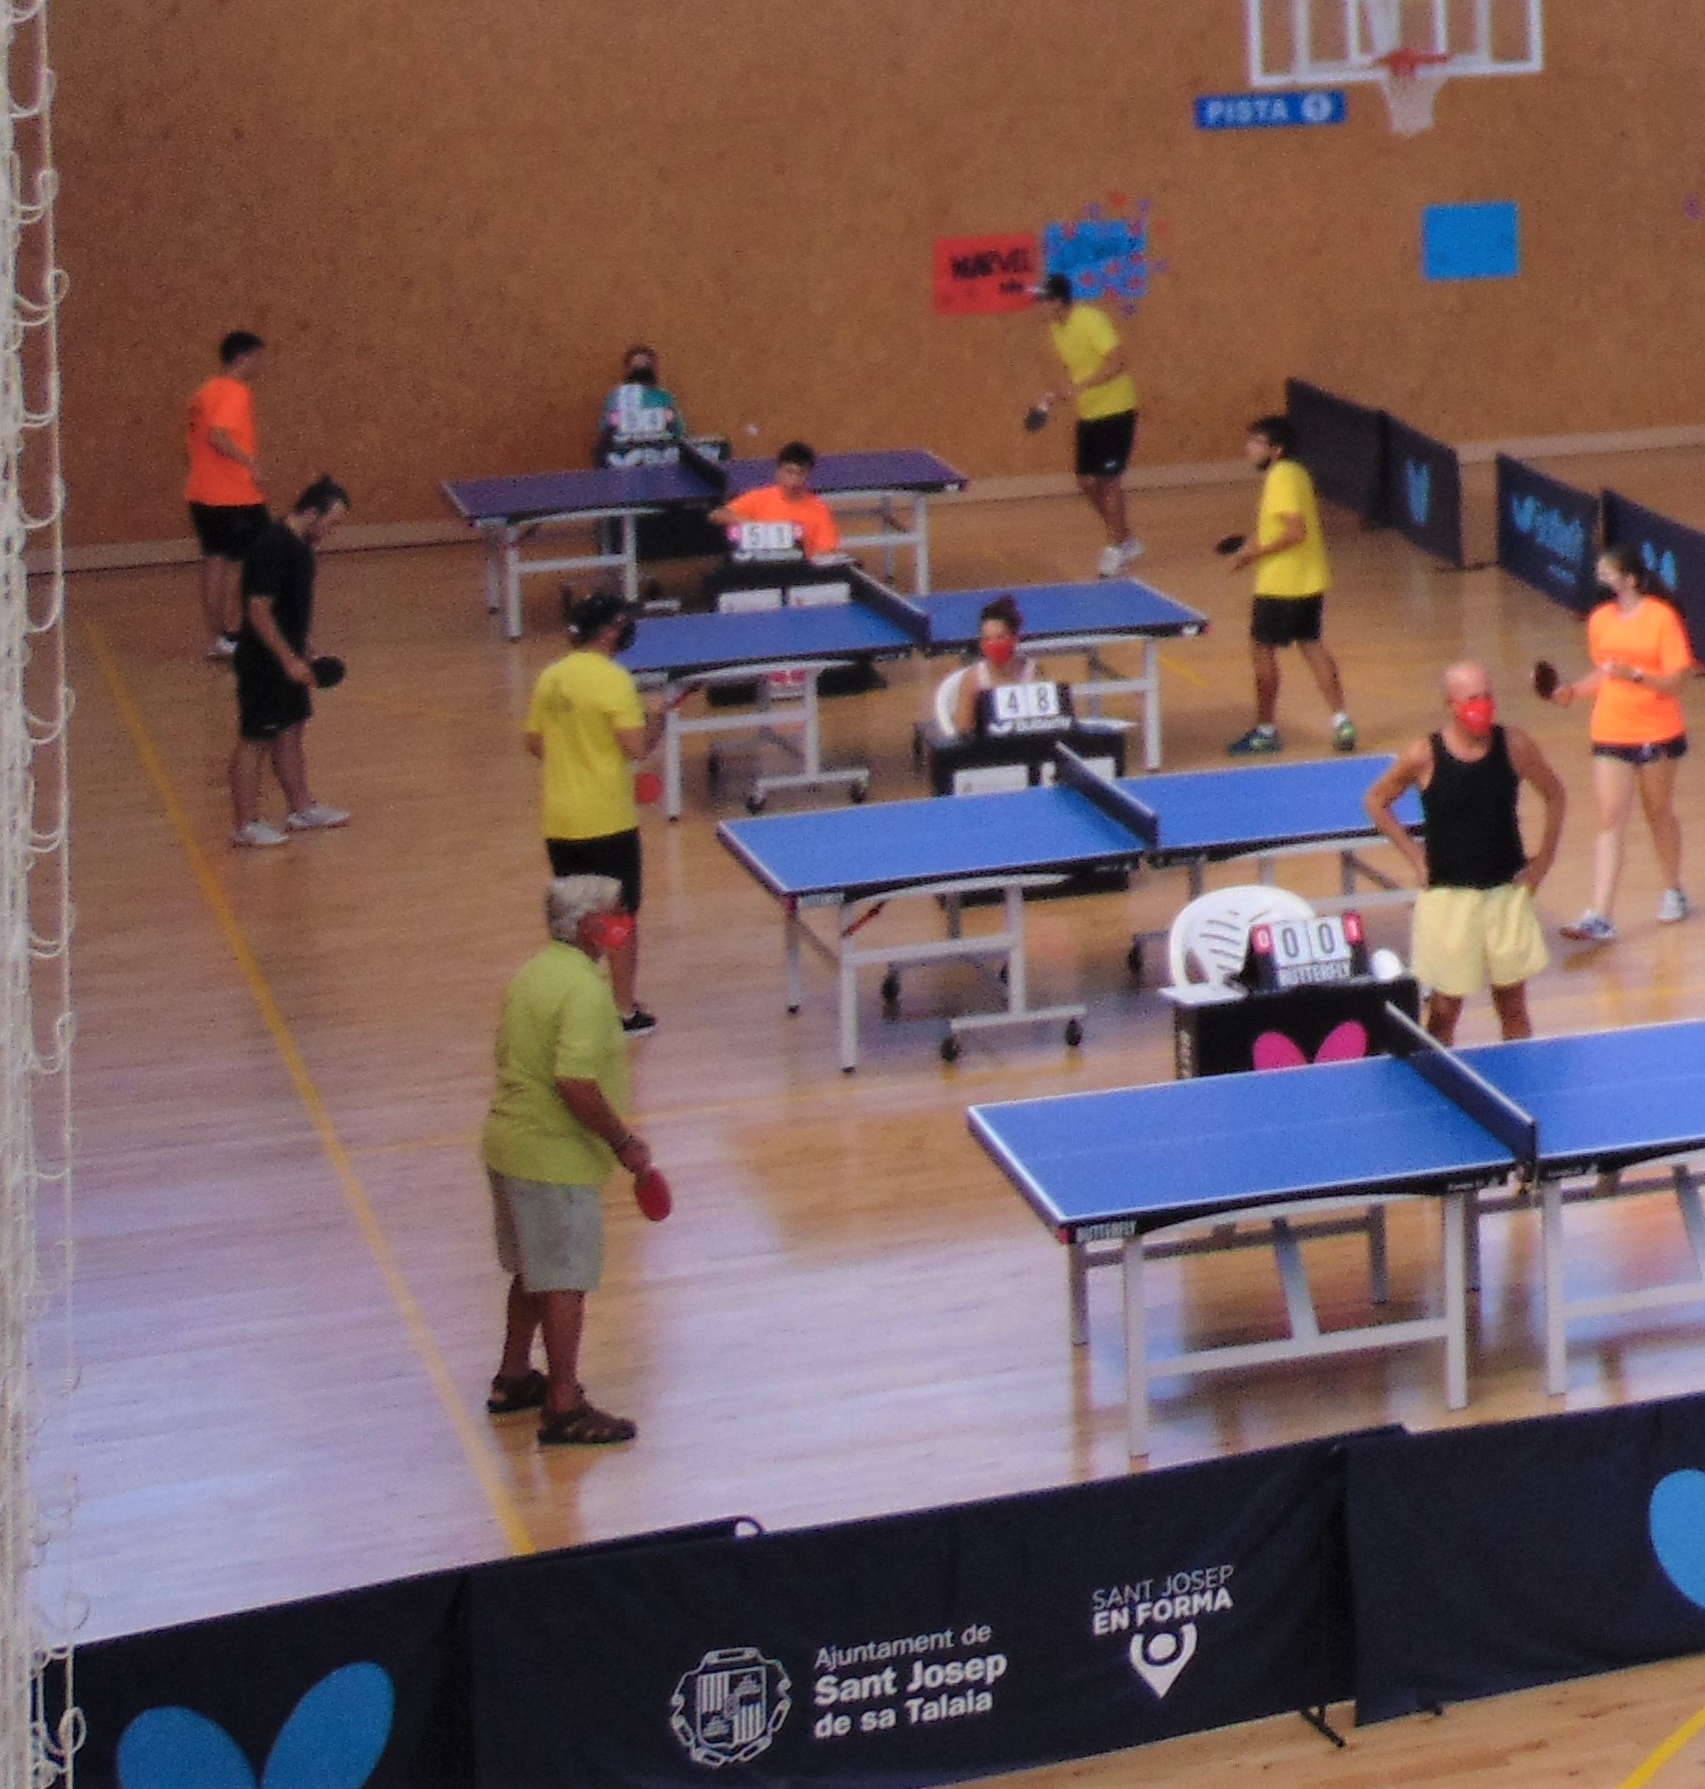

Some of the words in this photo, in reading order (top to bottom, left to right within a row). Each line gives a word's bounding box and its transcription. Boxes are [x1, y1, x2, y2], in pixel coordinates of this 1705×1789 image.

[1207, 98, 1289, 123] PISTA
[1282, 927, 1299, 958] 0
[1318, 923, 1335, 954] 0
[1092, 1578, 1155, 1610] SANT
[1160, 1564, 1235, 1597] JOSEP
[1093, 1607, 1130, 1637] EN
[1135, 1587, 1235, 1627] FORMA
[813, 1628, 956, 1672] Ajuntament
[961, 1622, 993, 1647] de
[813, 1664, 899, 1707] Sant
[906, 1652, 1009, 1694] Josep
[813, 1711, 852, 1739] de
[860, 1706, 898, 1733] sa
[904, 1687, 994, 1724] Talaia
